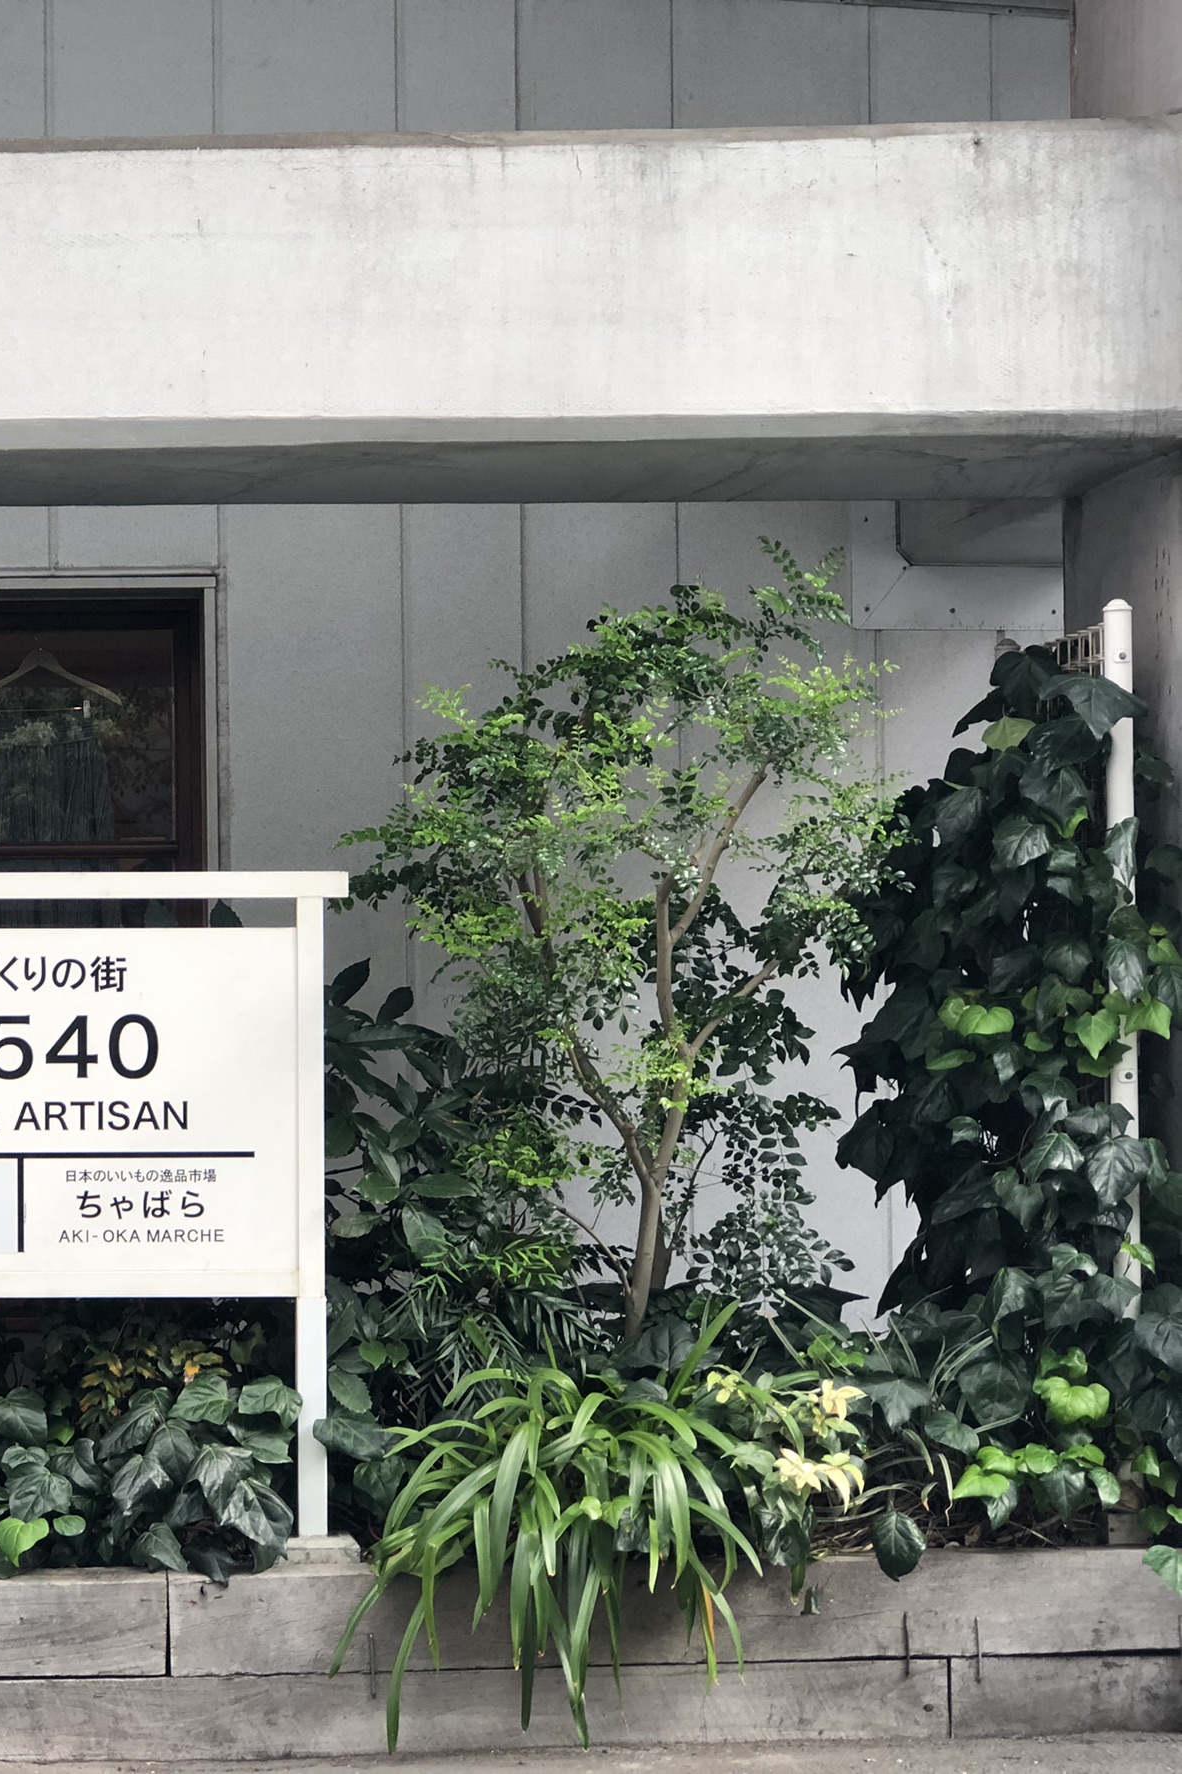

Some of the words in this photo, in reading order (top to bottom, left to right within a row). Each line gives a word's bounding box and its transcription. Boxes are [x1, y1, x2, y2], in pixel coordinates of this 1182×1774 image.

[13, 1100, 189, 1131] ARTISAN
[65, 1168, 217, 1183] 日本のいいもの逸品市場
[76, 1189, 206, 1220] ちゃばら
[146, 1228, 225, 1243] MARCHE
